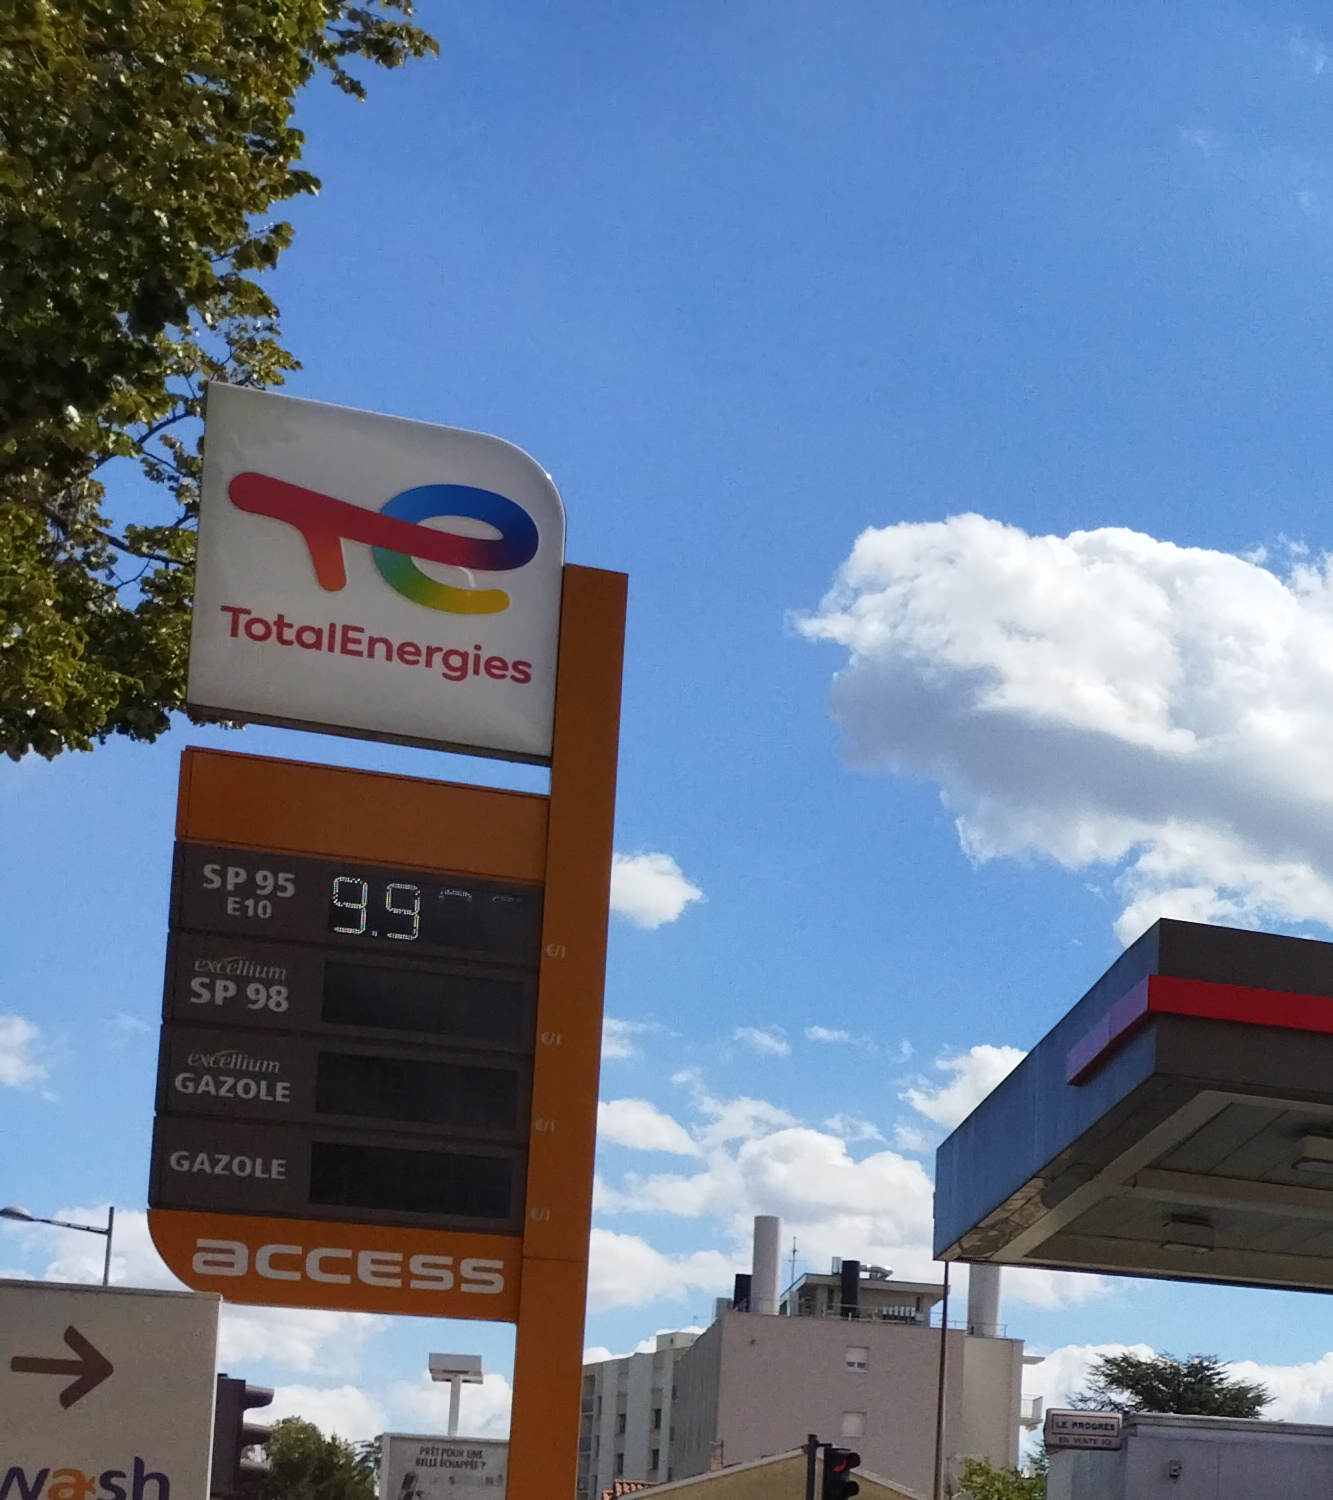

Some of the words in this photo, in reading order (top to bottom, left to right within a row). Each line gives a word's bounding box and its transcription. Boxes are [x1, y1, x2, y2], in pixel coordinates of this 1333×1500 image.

[220, 604, 533, 685] TotalEnergies
[203, 863, 247, 891] SP
[255, 870, 296, 898] 95
[227, 897, 272, 919] E10
[194, 956, 287, 981] excellium
[190, 976, 237, 1006] SP
[246, 982, 289, 1012] 98
[187, 1049, 280, 1074] excellium
[174, 1072, 292, 1103] GAZOLE
[169, 1150, 287, 1180] GAZOLE
[1055, 1421, 1068, 1429] LE
